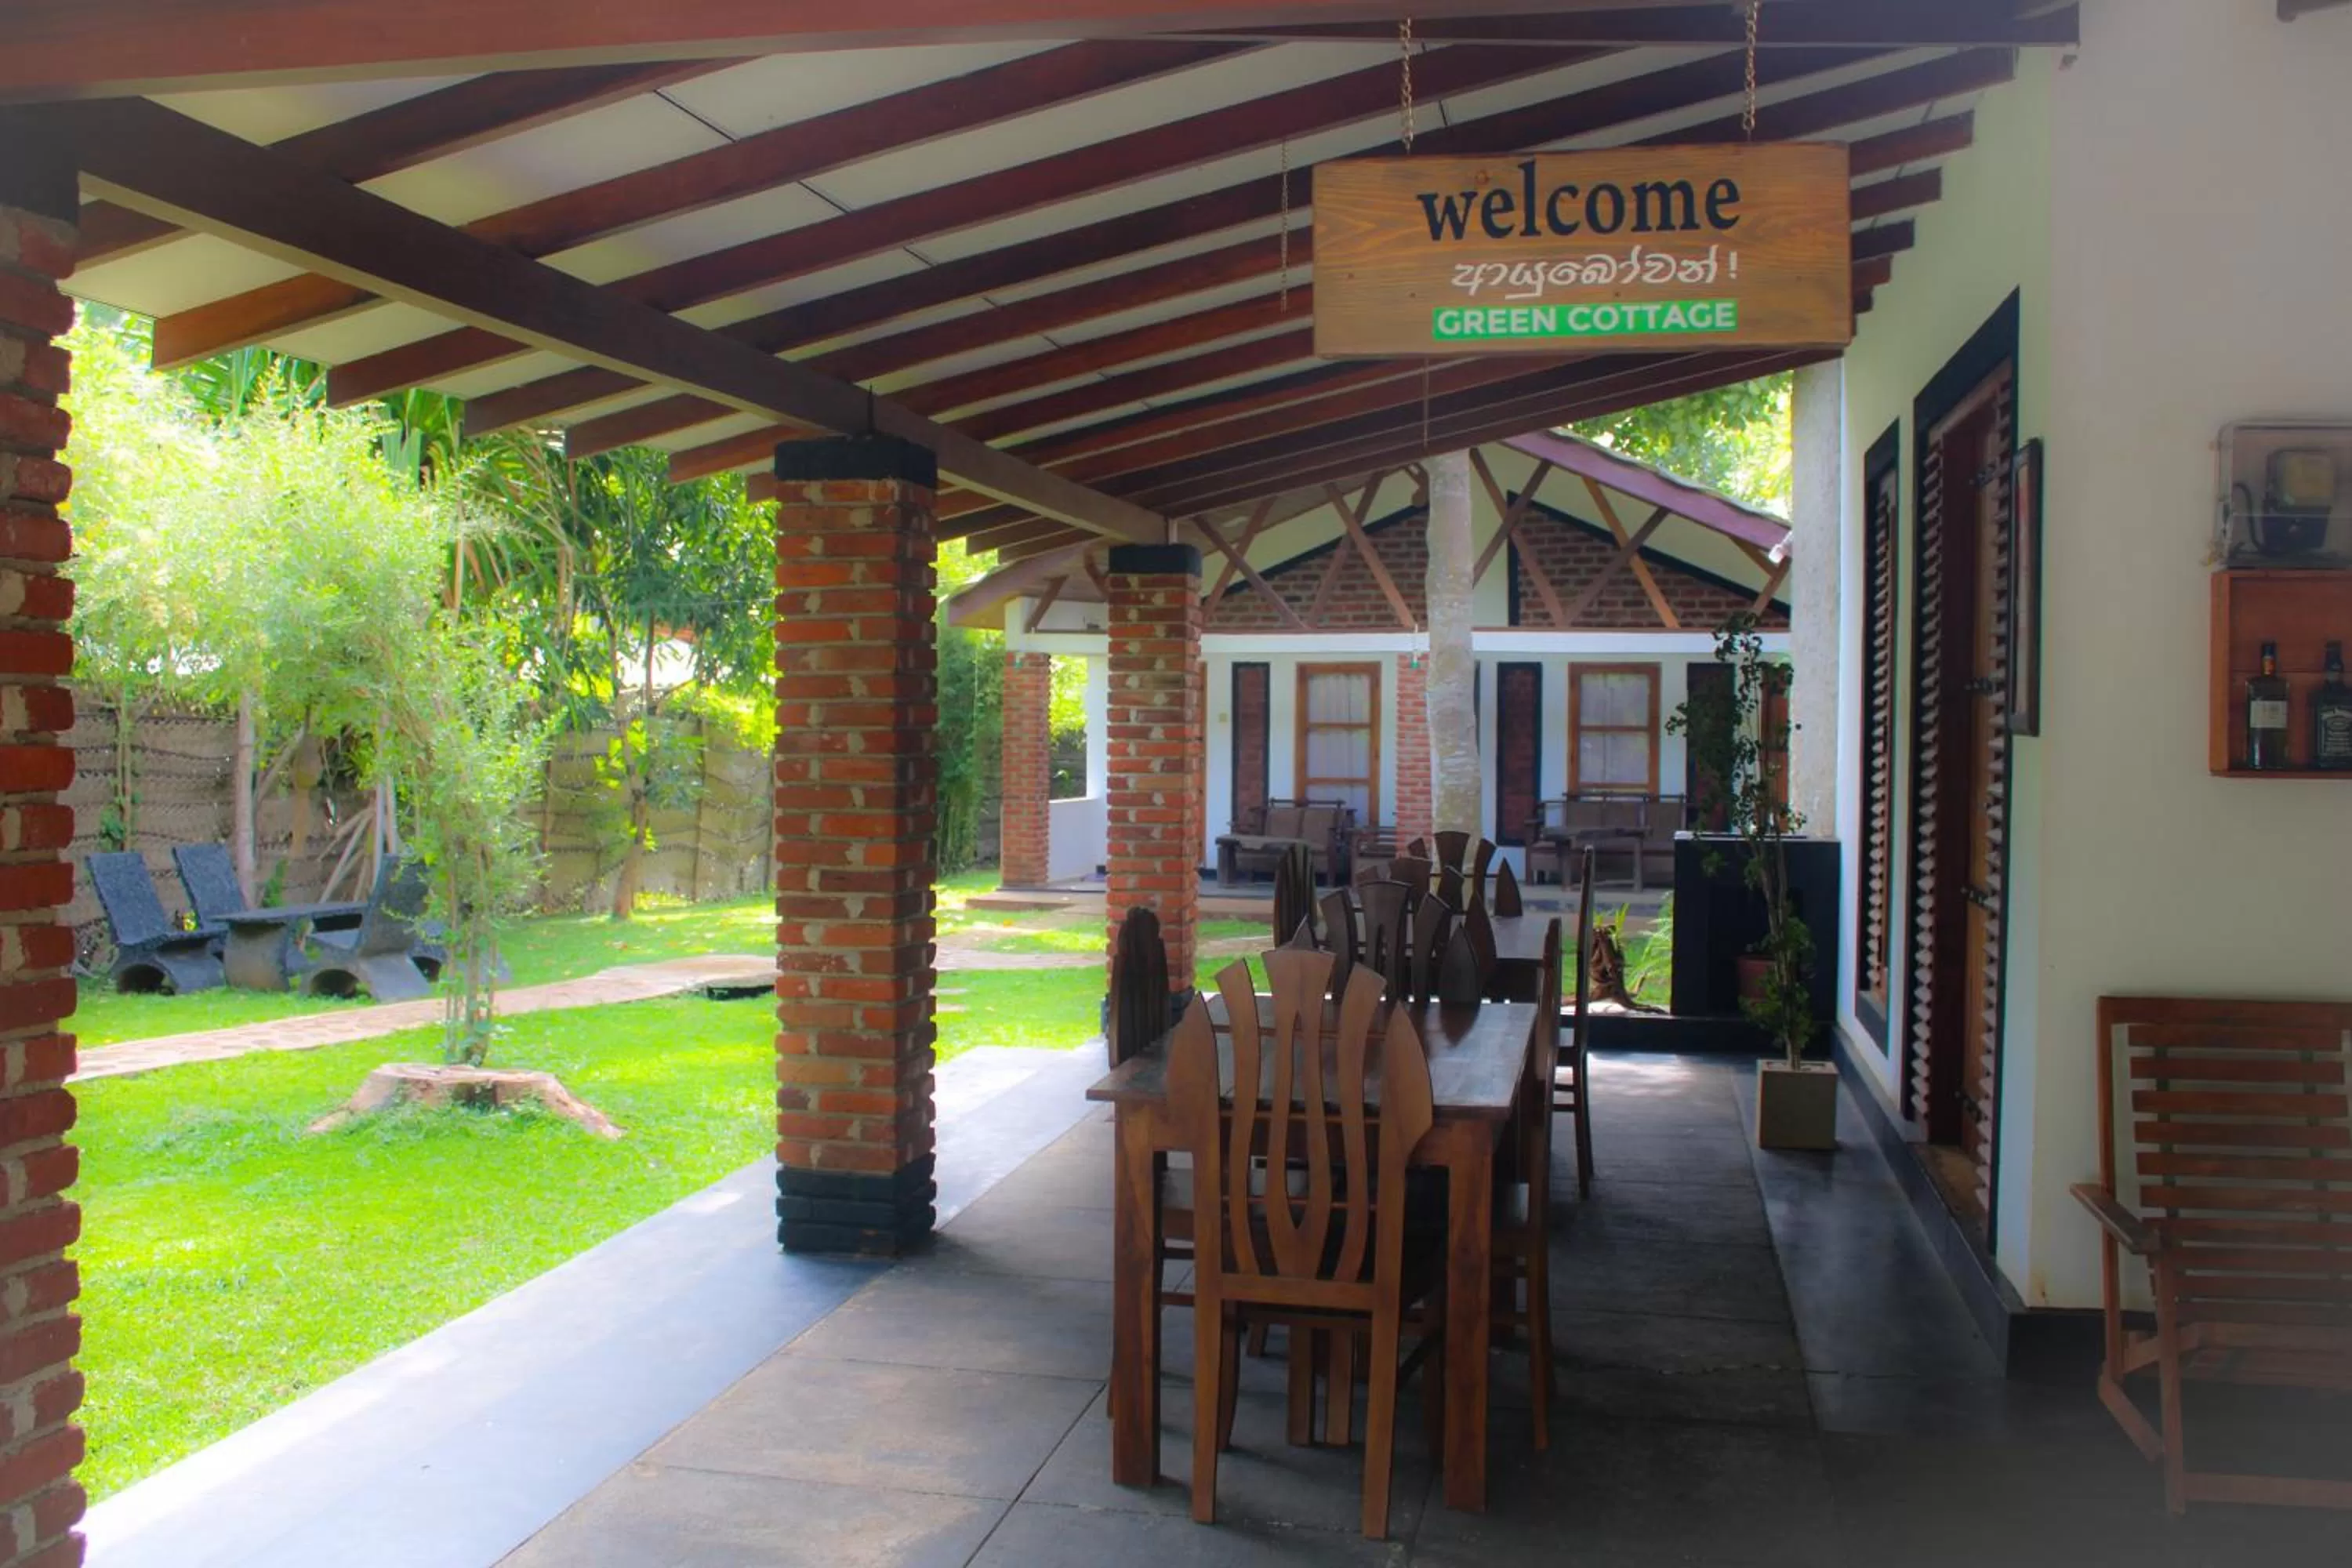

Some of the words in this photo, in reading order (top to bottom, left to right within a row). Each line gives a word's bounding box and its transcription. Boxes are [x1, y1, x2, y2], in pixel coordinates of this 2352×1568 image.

[1417, 159, 1740, 241] welcome
[1437, 309, 1557, 335] GREEN
[1567, 302, 1736, 331] COTTAGE
